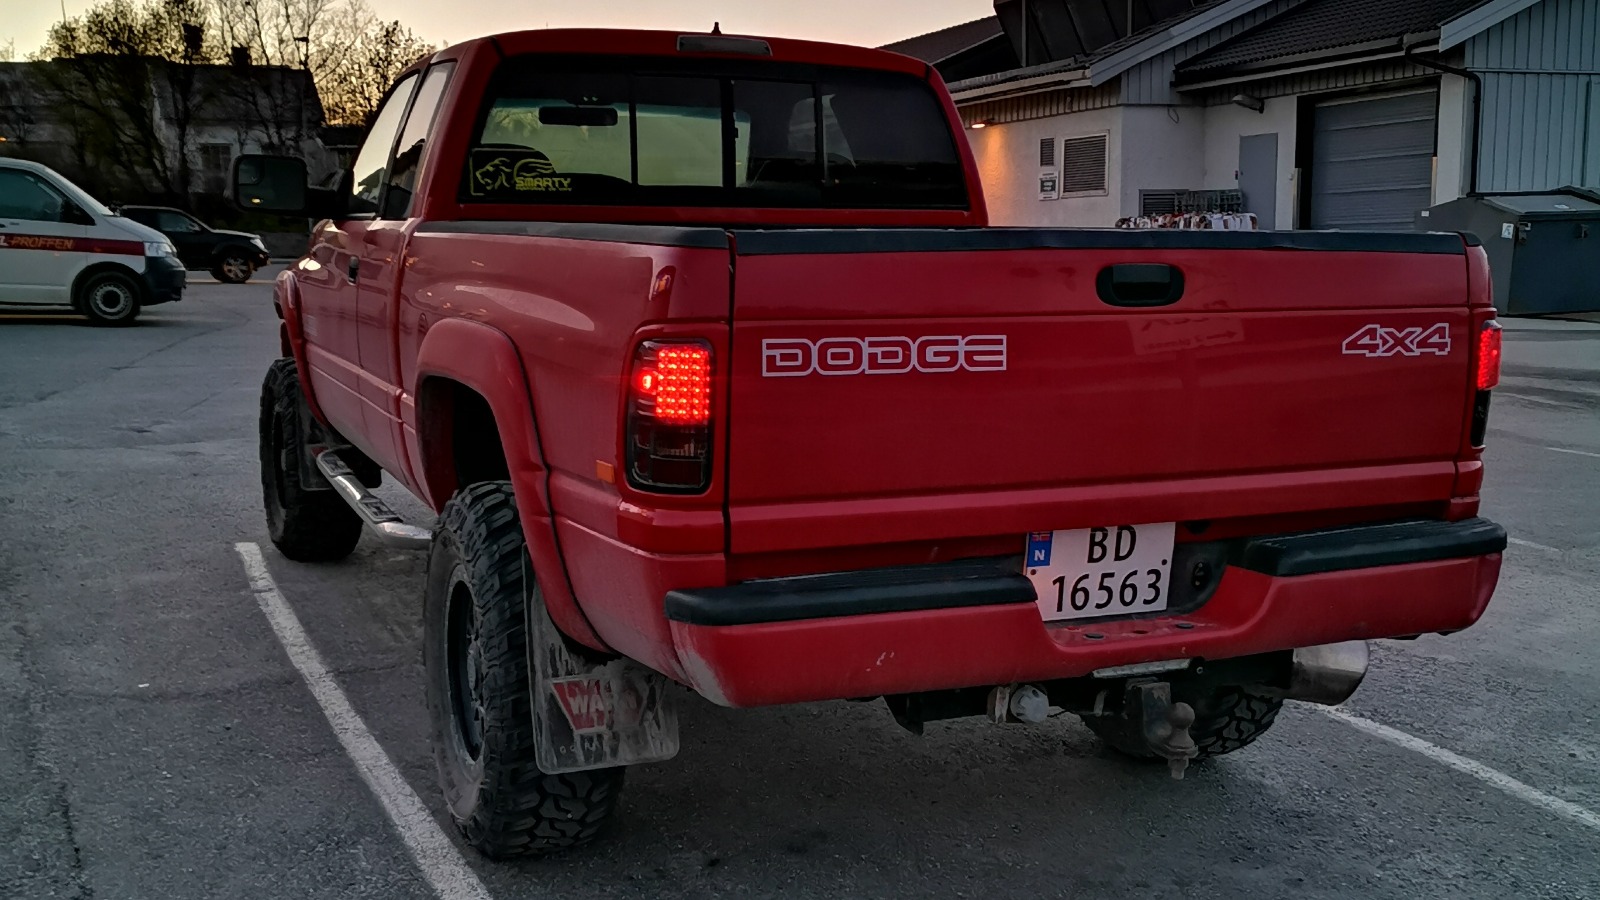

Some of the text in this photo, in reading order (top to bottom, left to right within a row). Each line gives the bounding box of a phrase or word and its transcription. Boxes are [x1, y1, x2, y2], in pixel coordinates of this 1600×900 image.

[515, 177, 572, 188] SMARTY
[762, 335, 1007, 377] DODGE
[1034, 549, 1045, 562] N
[1087, 525, 1137, 564] BD
[1052, 569, 1162, 613] 16563
